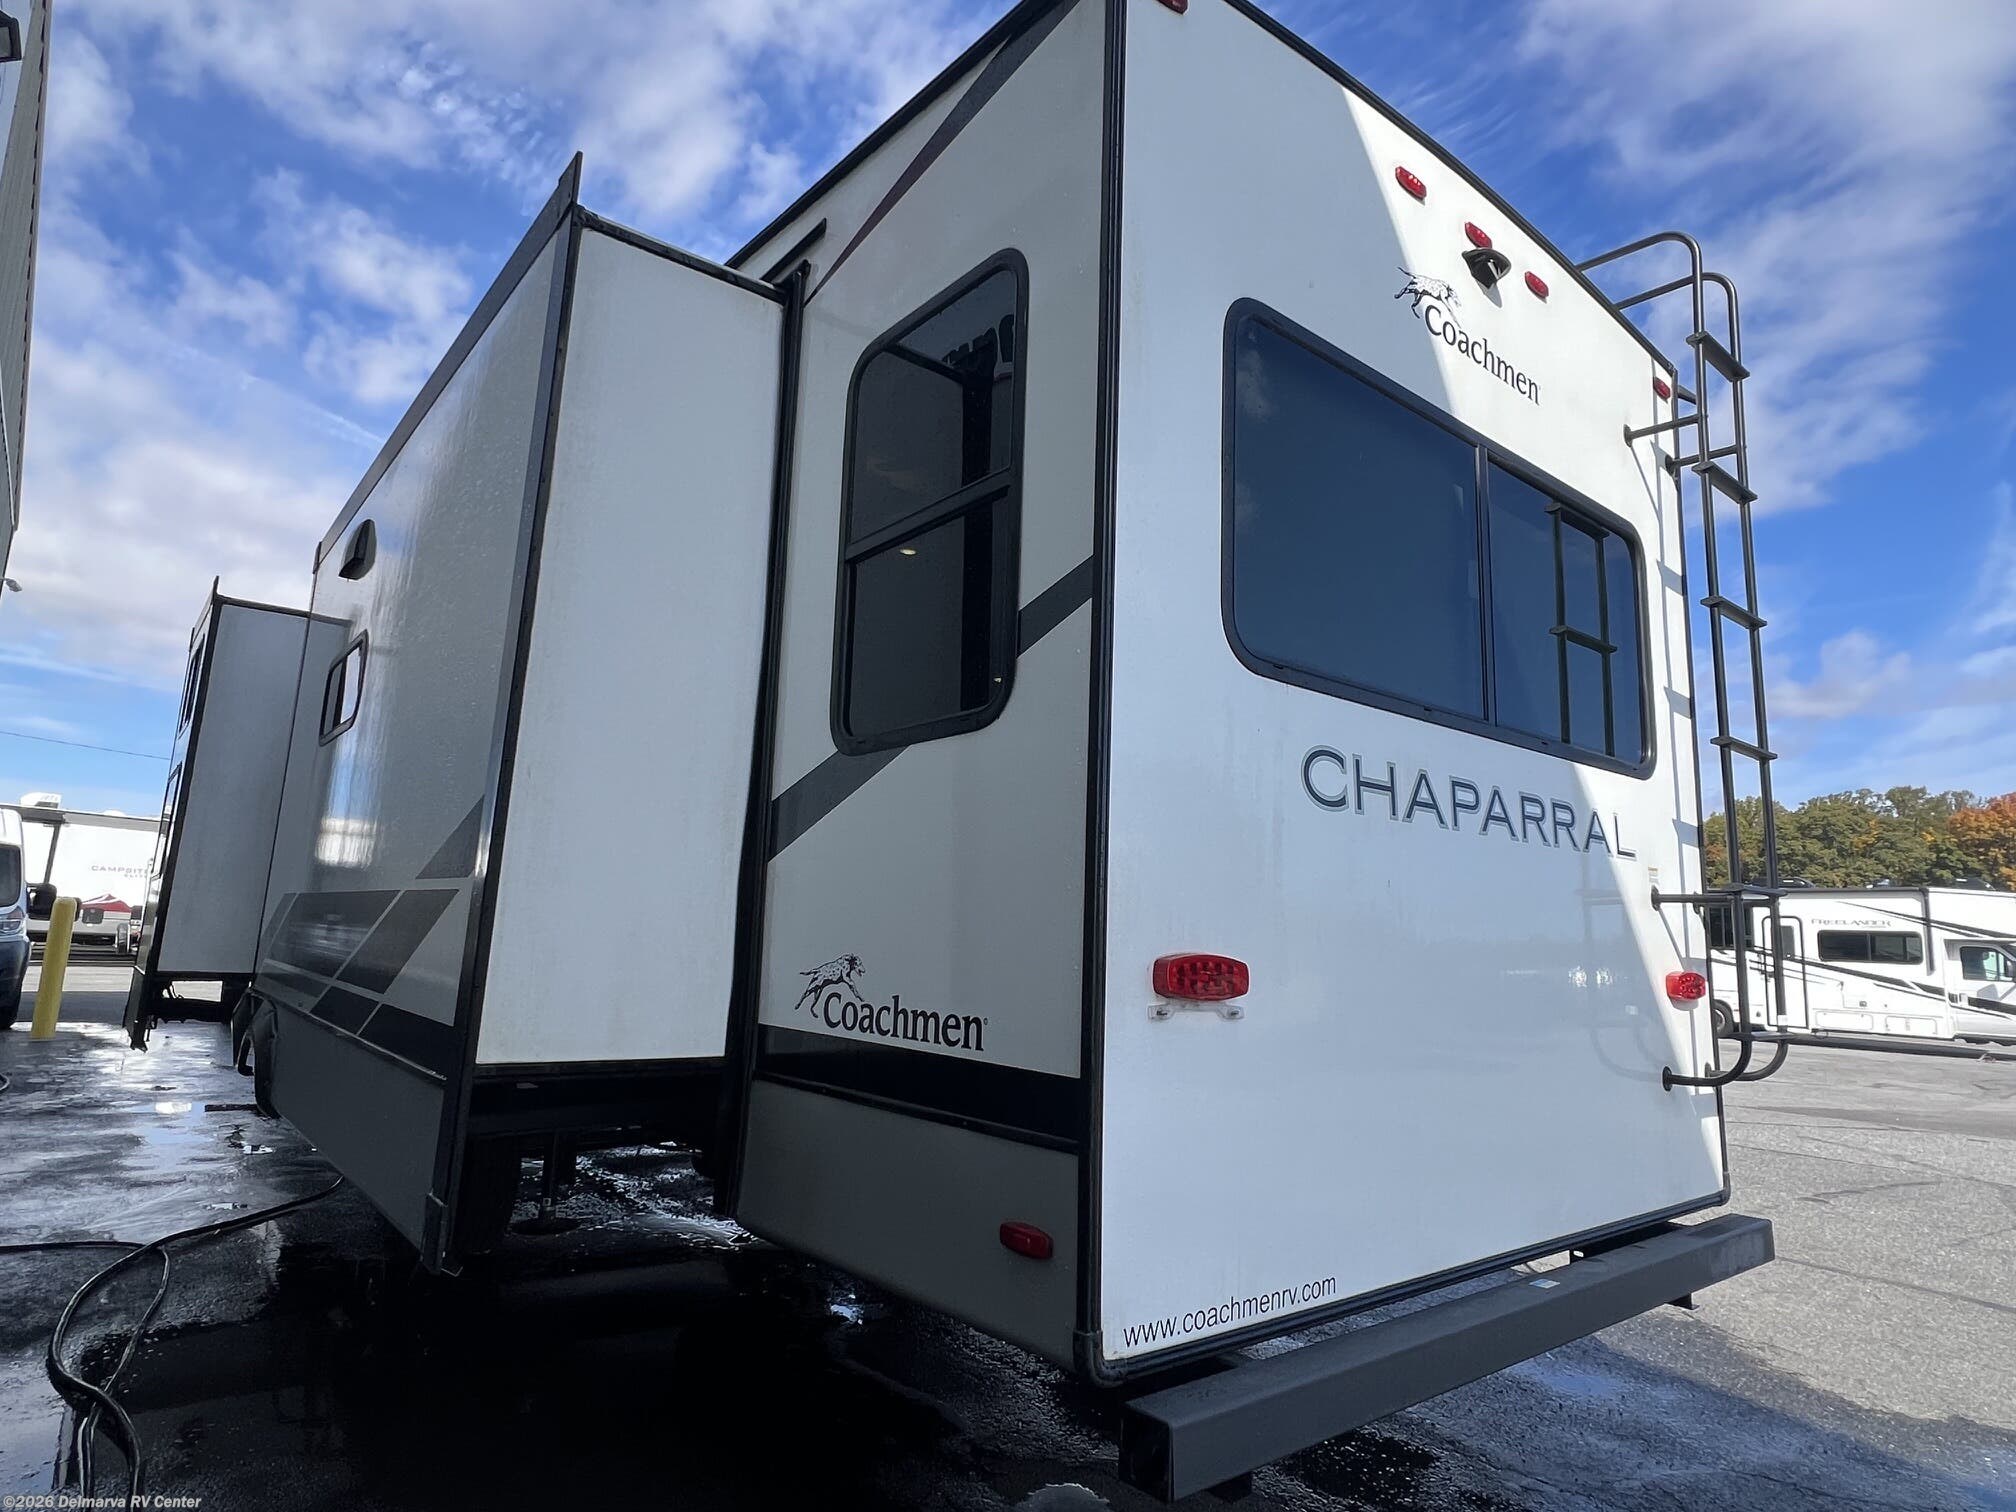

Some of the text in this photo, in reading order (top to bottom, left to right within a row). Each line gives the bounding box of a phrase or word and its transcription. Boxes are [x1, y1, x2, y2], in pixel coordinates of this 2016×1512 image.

[1425, 305, 1540, 405] Coachmen
[1301, 745, 1637, 861] CHAPARRAL
[823, 992, 985, 1051] Coachmen
[1123, 1277, 1336, 1347] www.coachmenrv.com
